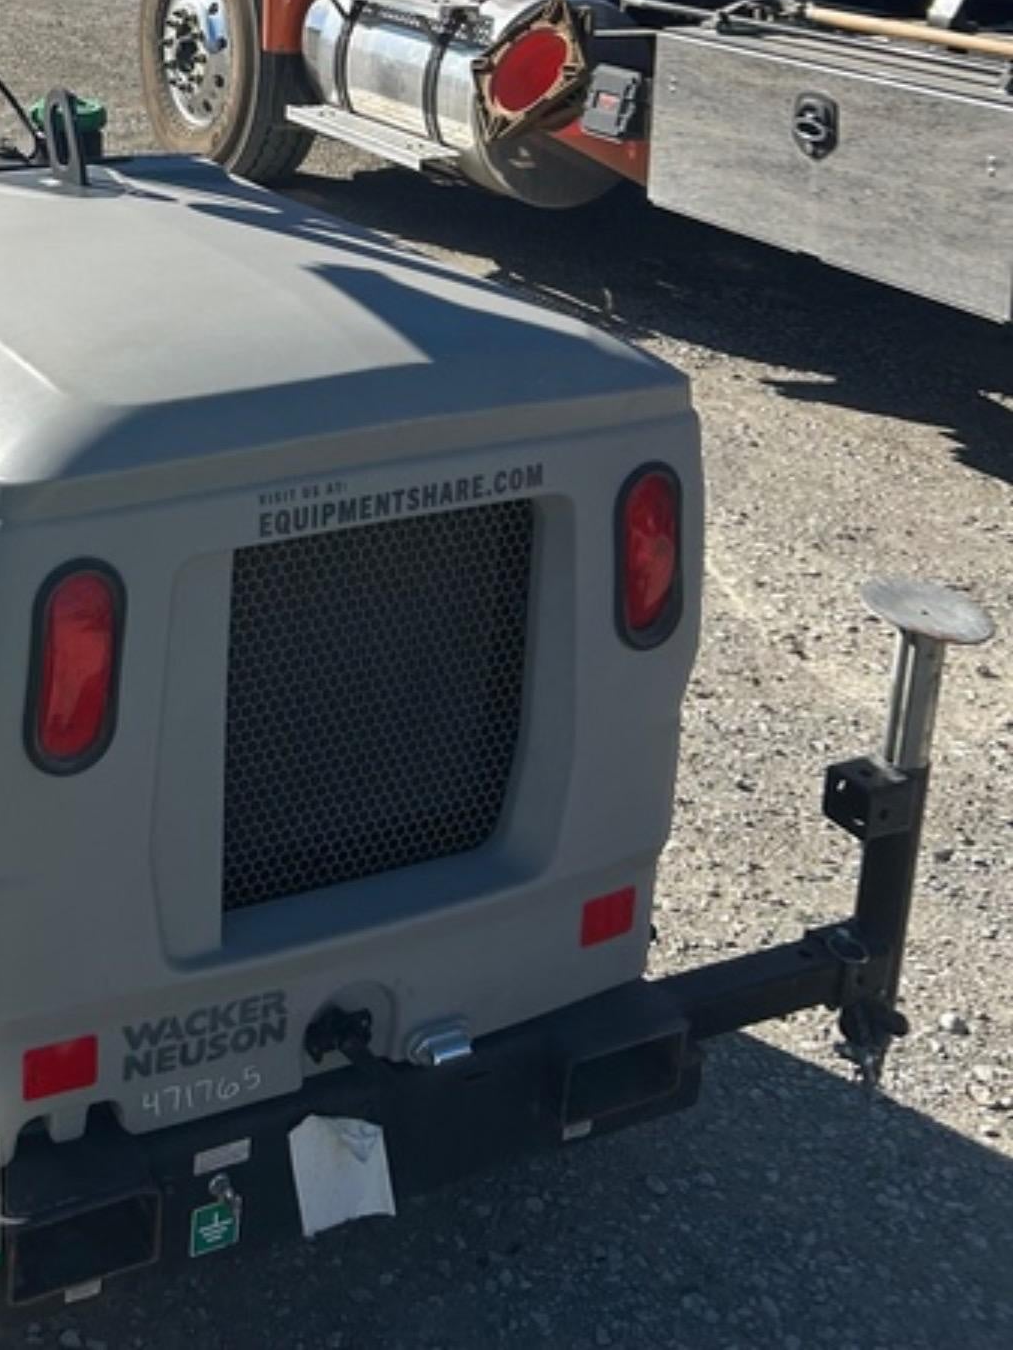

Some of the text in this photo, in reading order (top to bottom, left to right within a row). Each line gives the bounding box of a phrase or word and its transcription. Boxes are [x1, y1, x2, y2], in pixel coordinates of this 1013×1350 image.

[259, 463, 544, 538] EQUIPMENTSHARE.COM
[122, 989, 288, 1050] WACKER
[122, 1016, 287, 1081] NEUSON
[141, 1064, 262, 1115] 471765
